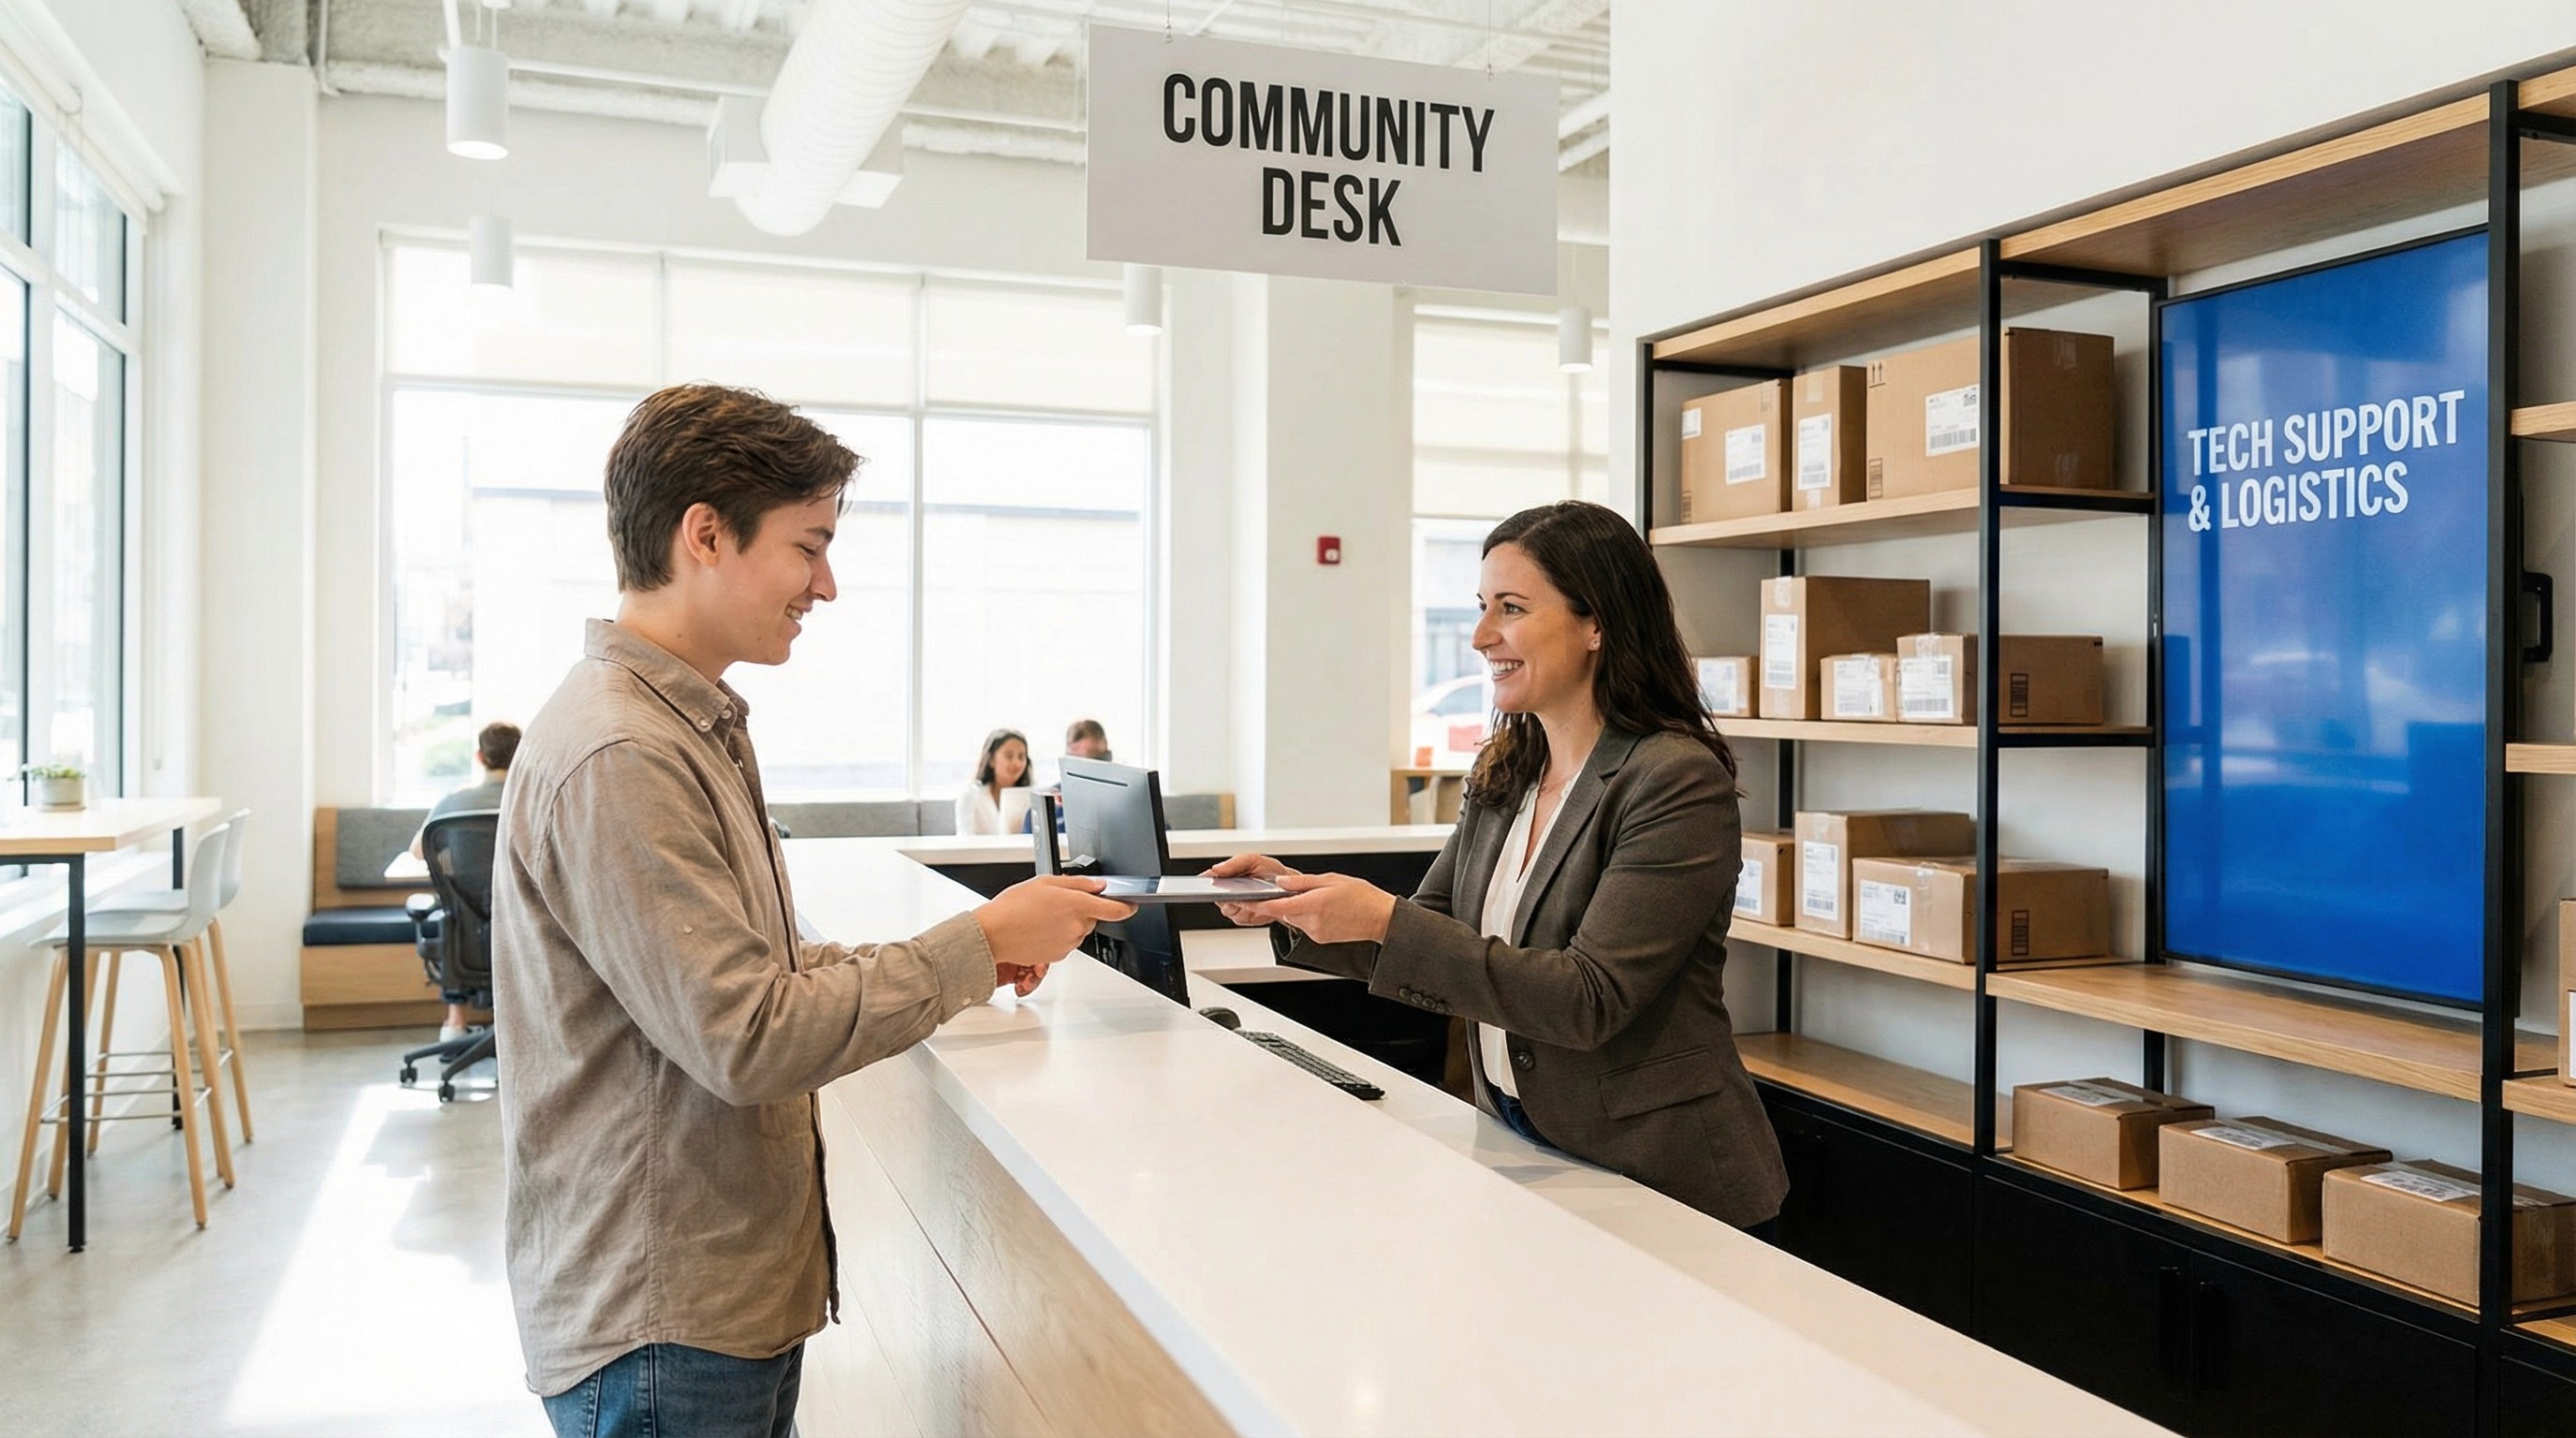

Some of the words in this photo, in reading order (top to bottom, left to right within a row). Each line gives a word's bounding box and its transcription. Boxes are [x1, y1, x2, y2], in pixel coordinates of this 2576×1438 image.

[1164, 73, 1495, 172] COMMUNITY
[1262, 167, 1401, 246] DESK
[2188, 418, 2274, 476] TECH
[2284, 389, 2465, 464] SUPPORT
[2188, 485, 2211, 532] &
[2221, 461, 2408, 528] LOGISTICS
